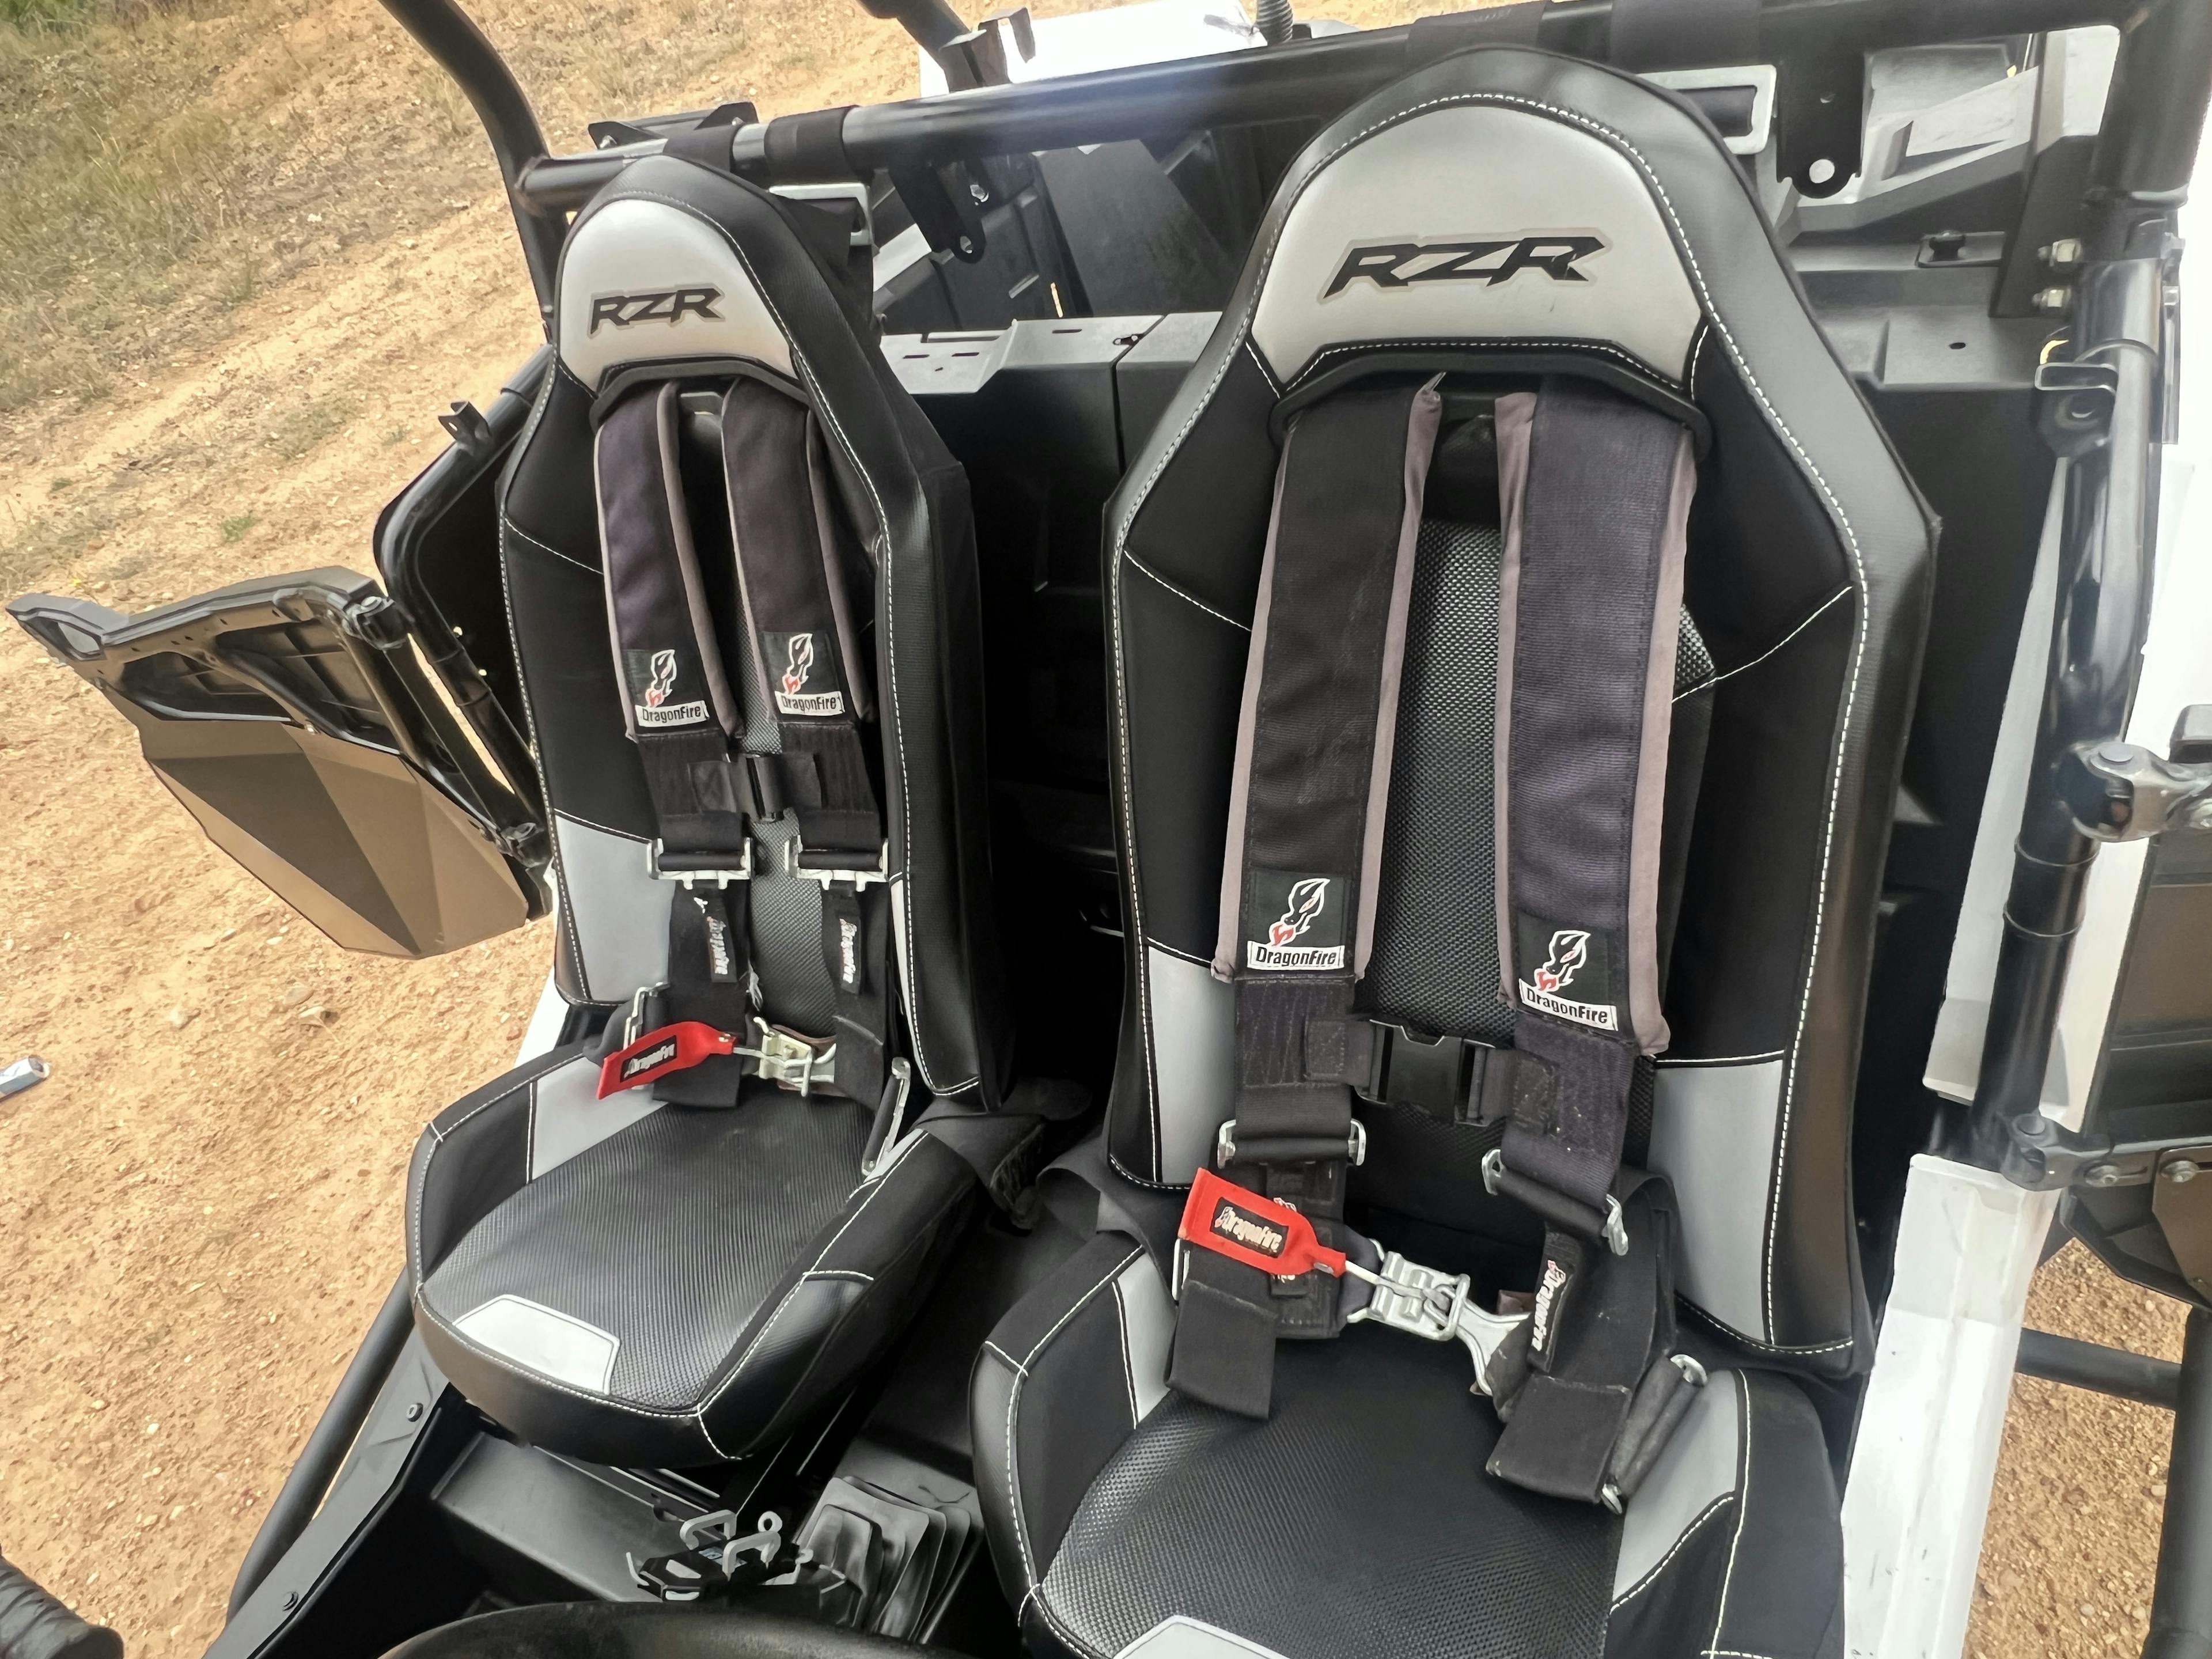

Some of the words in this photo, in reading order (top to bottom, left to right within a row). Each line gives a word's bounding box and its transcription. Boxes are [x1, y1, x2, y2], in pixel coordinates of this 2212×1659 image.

[1323, 237, 1605, 300] RZR
[590, 287, 722, 335] RZR
[641, 705, 701, 724] DragonFire
[781, 695, 836, 711] DragonFire
[1256, 946, 1338, 967] DragonFire
[1527, 987, 1608, 1024] DragonFire
